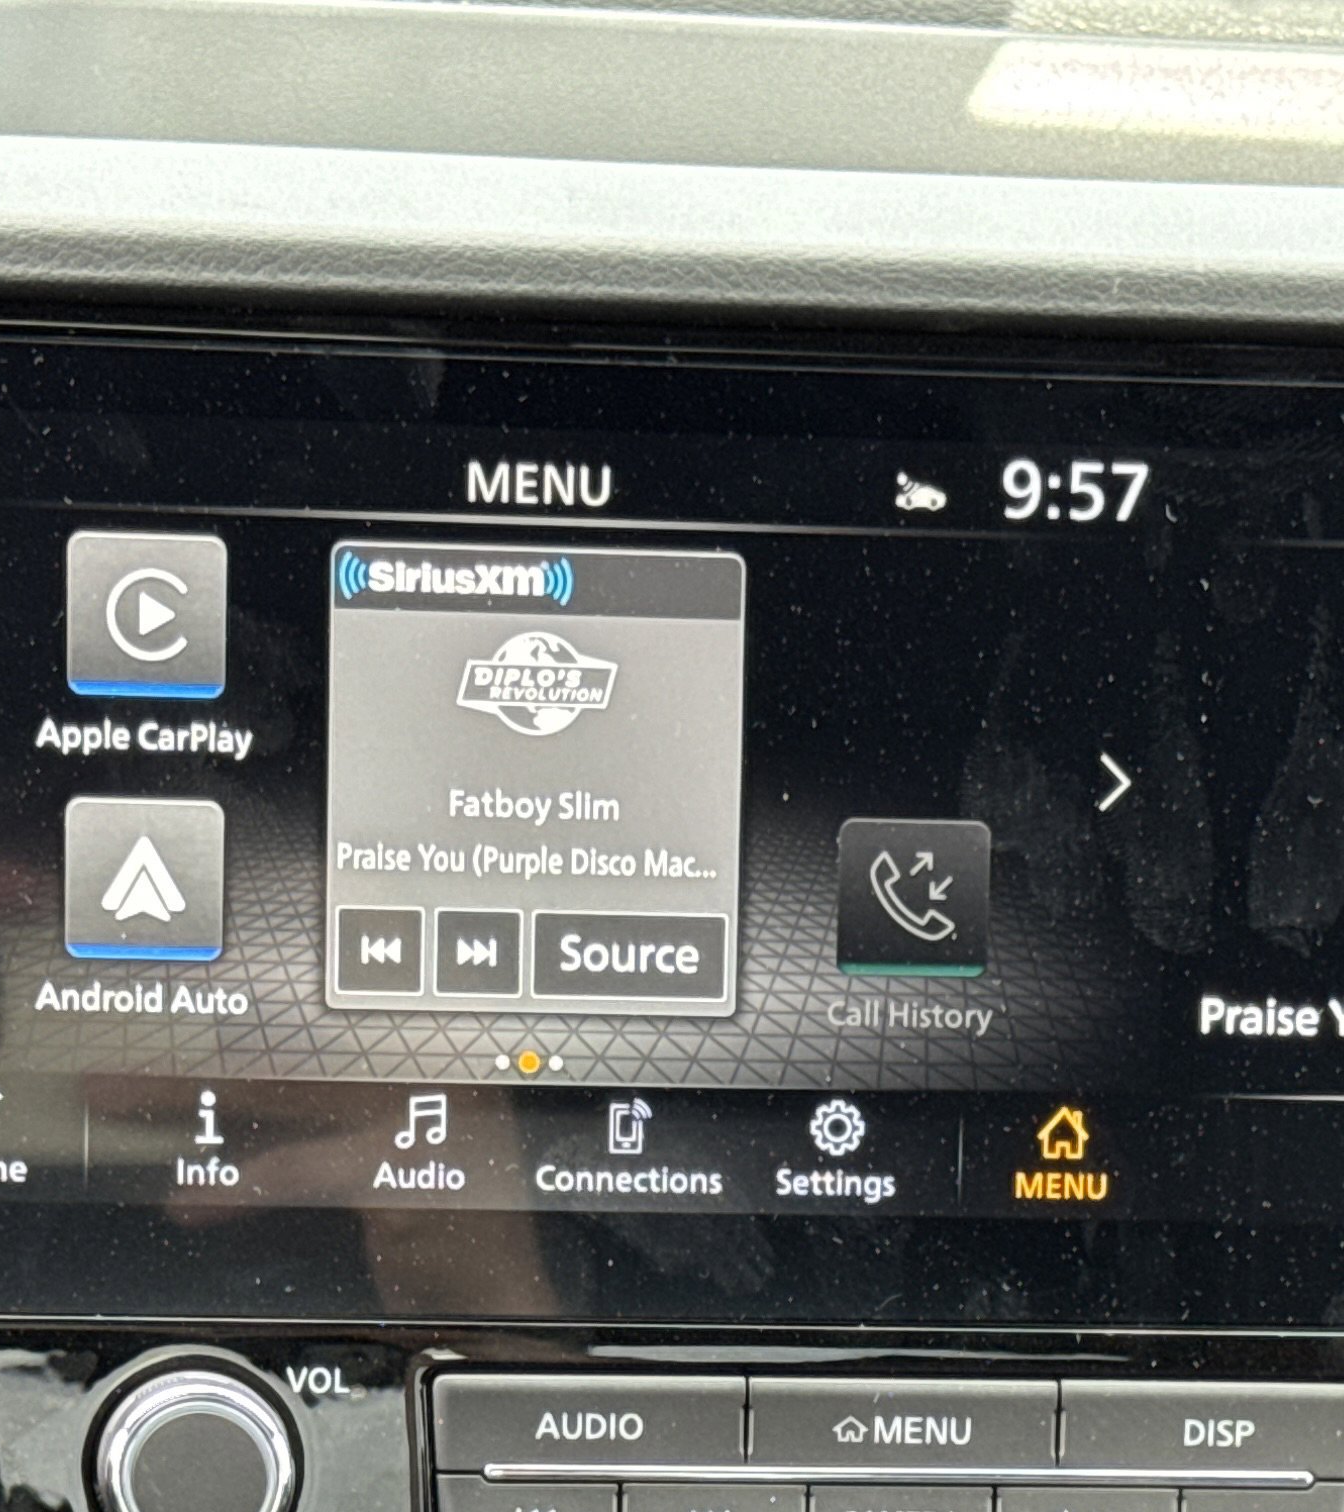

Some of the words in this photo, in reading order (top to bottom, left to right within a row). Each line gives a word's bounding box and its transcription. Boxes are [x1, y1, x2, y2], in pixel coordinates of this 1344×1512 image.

[466, 460, 612, 507] MENU
[1000, 458, 1149, 521] 9:57
[474, 667, 582, 688] DIPLO'S
[489, 686, 603, 703] REVOLUTION
[35, 716, 131, 756] Apple
[137, 720, 254, 761] CarPlay
[448, 788, 552, 826] Fatboy
[558, 790, 620, 821] Slim
[336, 841, 411, 872] Praise
[417, 844, 465, 873] You
[472, 844, 563, 880] (Purple
[571, 847, 636, 878] Disco
[644, 849, 717, 879] Mac...
[559, 932, 700, 974] Source
[34, 979, 163, 1013] Android
[170, 984, 249, 1015] Auto
[826, 1000, 880, 1028] Call
[888, 1002, 993, 1036] History
[1199, 996, 1320, 1037] Praise
[176, 1156, 240, 1187] Info
[372, 1160, 466, 1191] Audio
[535, 1164, 722, 1194] Connections
[775, 1167, 896, 1203] Settings
[1014, 1171, 1108, 1200] MENU
[286, 1366, 351, 1394] VOL
[534, 1412, 644, 1441] AUDIO
[873, 1416, 973, 1446] MENU
[1182, 1418, 1256, 1447] DISP
